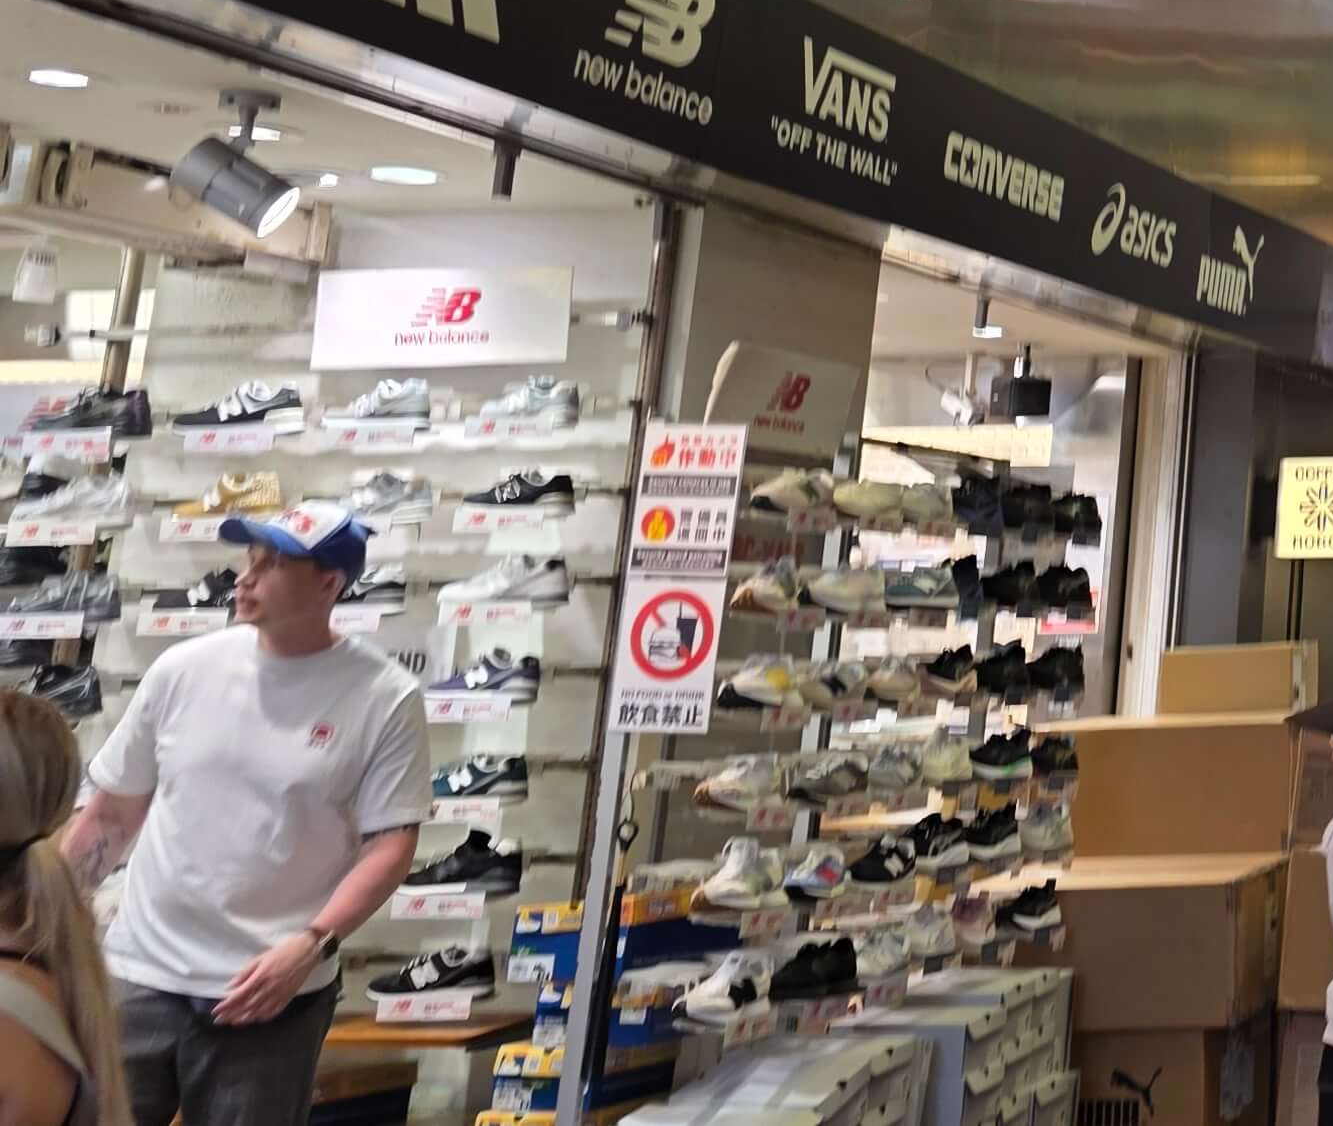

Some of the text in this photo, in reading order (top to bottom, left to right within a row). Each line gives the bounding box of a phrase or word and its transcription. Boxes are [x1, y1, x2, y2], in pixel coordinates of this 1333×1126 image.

[573, 48, 713, 126] new balance
[803, 34, 897, 143] VANS
[770, 114, 898, 187] "OFF THE WALL"
[943, 129, 1065, 223] CONVERSE
[1195, 253, 1247, 317] PUMA
[394, 329, 490, 346] new balance
